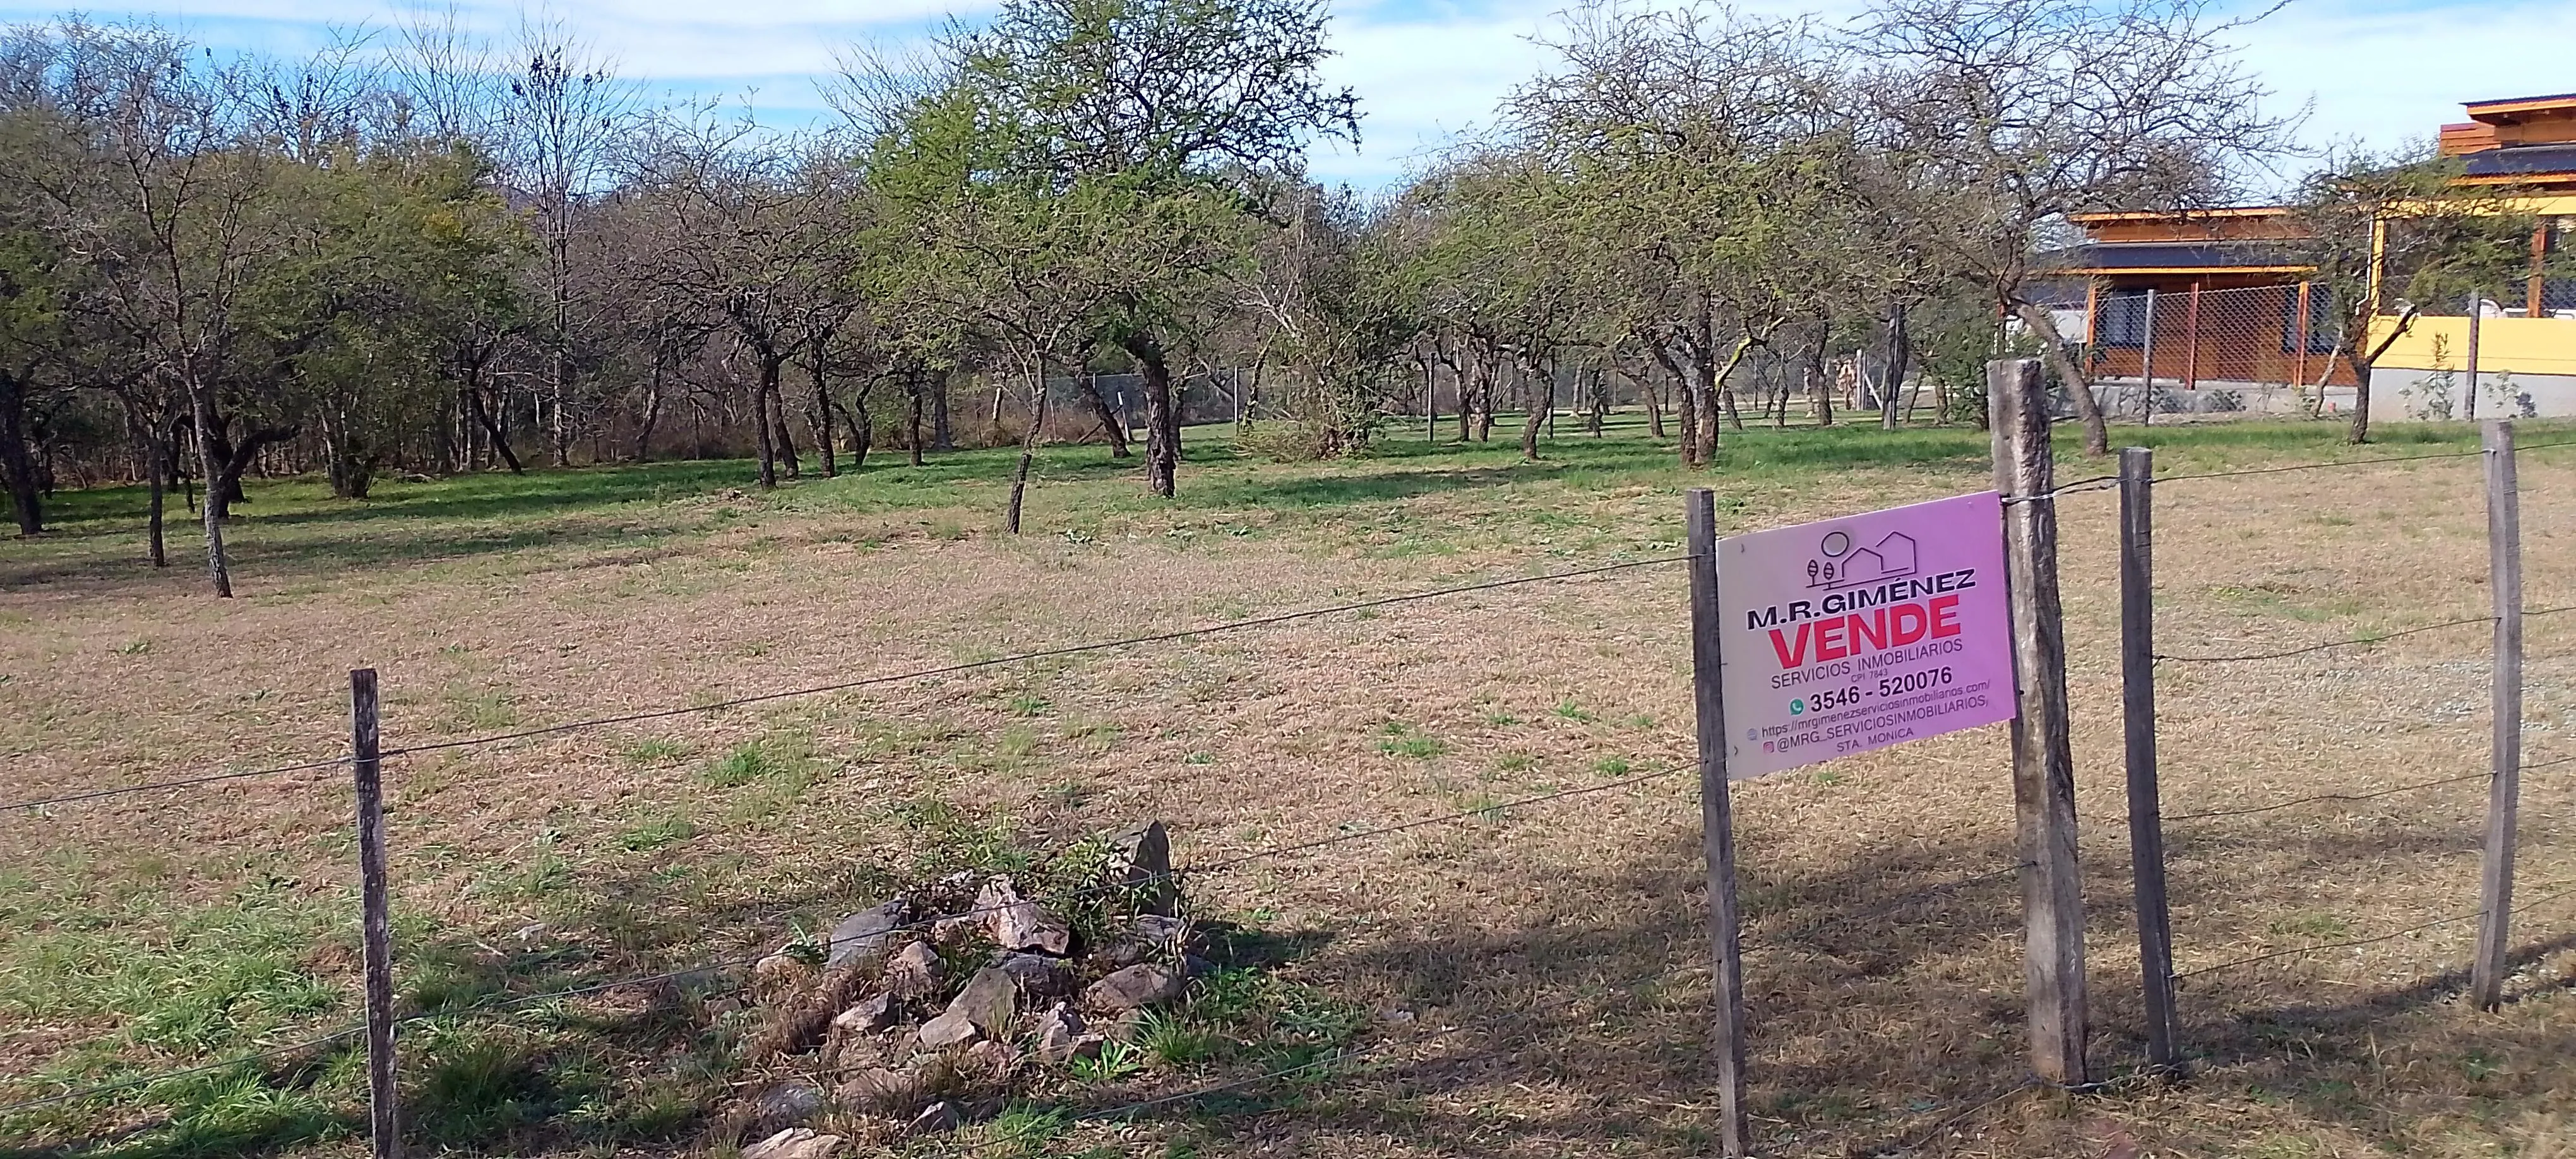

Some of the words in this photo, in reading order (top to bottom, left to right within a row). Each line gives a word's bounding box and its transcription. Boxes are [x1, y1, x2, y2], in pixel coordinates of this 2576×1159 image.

[1748, 568, 1976, 630] M.R.GIMÉNEZ
[1767, 594, 1961, 670] VENDE
[1771, 662, 1851, 689] SERVICIOS
[1857, 638, 1962, 671] INMOBILIARIOS
[1851, 674, 1866, 683] CPI
[1869, 669, 1888, 679] 7843
[1810, 686, 1860, 712] 3546
[1879, 667, 1952, 698] 520076
[1868, 727, 1914, 746] MONICA
